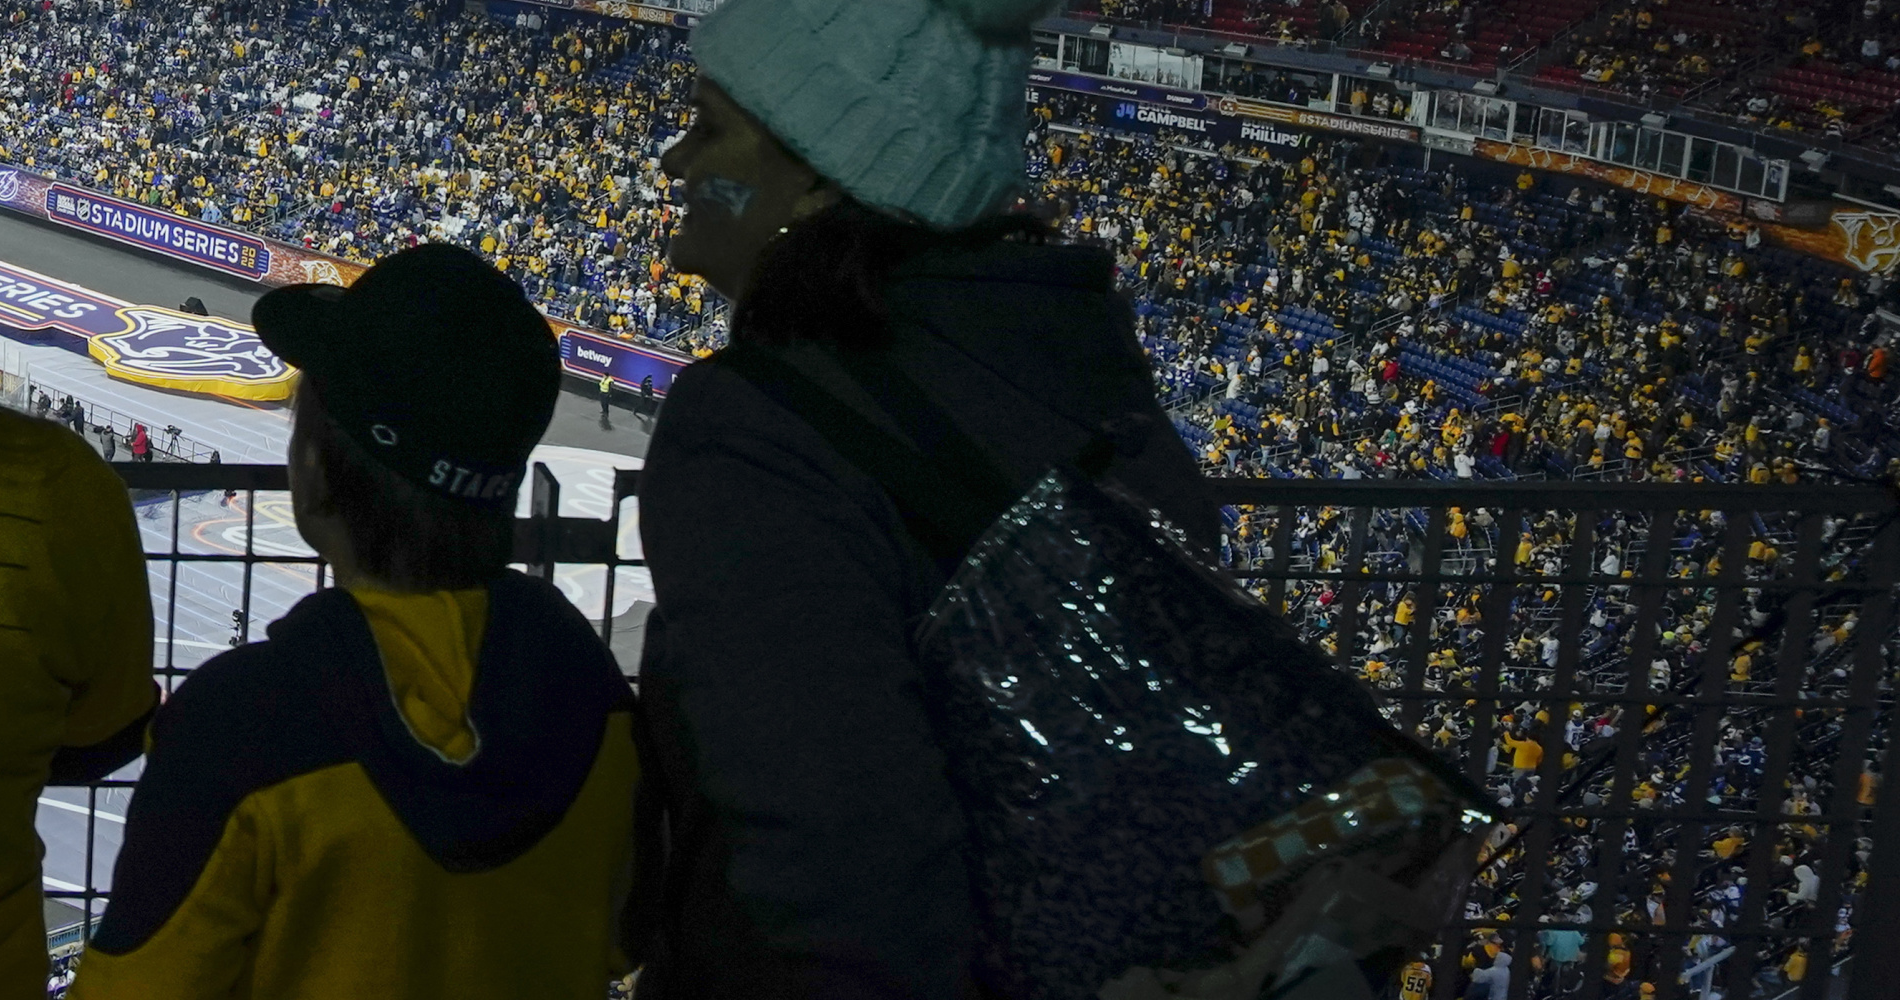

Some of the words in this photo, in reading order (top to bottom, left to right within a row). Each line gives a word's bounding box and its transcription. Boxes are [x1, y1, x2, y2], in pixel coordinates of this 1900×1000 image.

[638, 8, 666, 23] NSH
[1136, 110, 1207, 132] CAMPBELL
[1299, 112, 1409, 140] #STADIUMSERIES
[1240, 128, 1299, 148] PHILLIPS
[91, 202, 173, 246] STADIUM
[171, 226, 241, 264] SERIES
[241, 244, 257, 256] 20
[241, 254, 257, 267] 22
[576, 345, 613, 367] betway
[1406, 976, 1426, 993] 59
